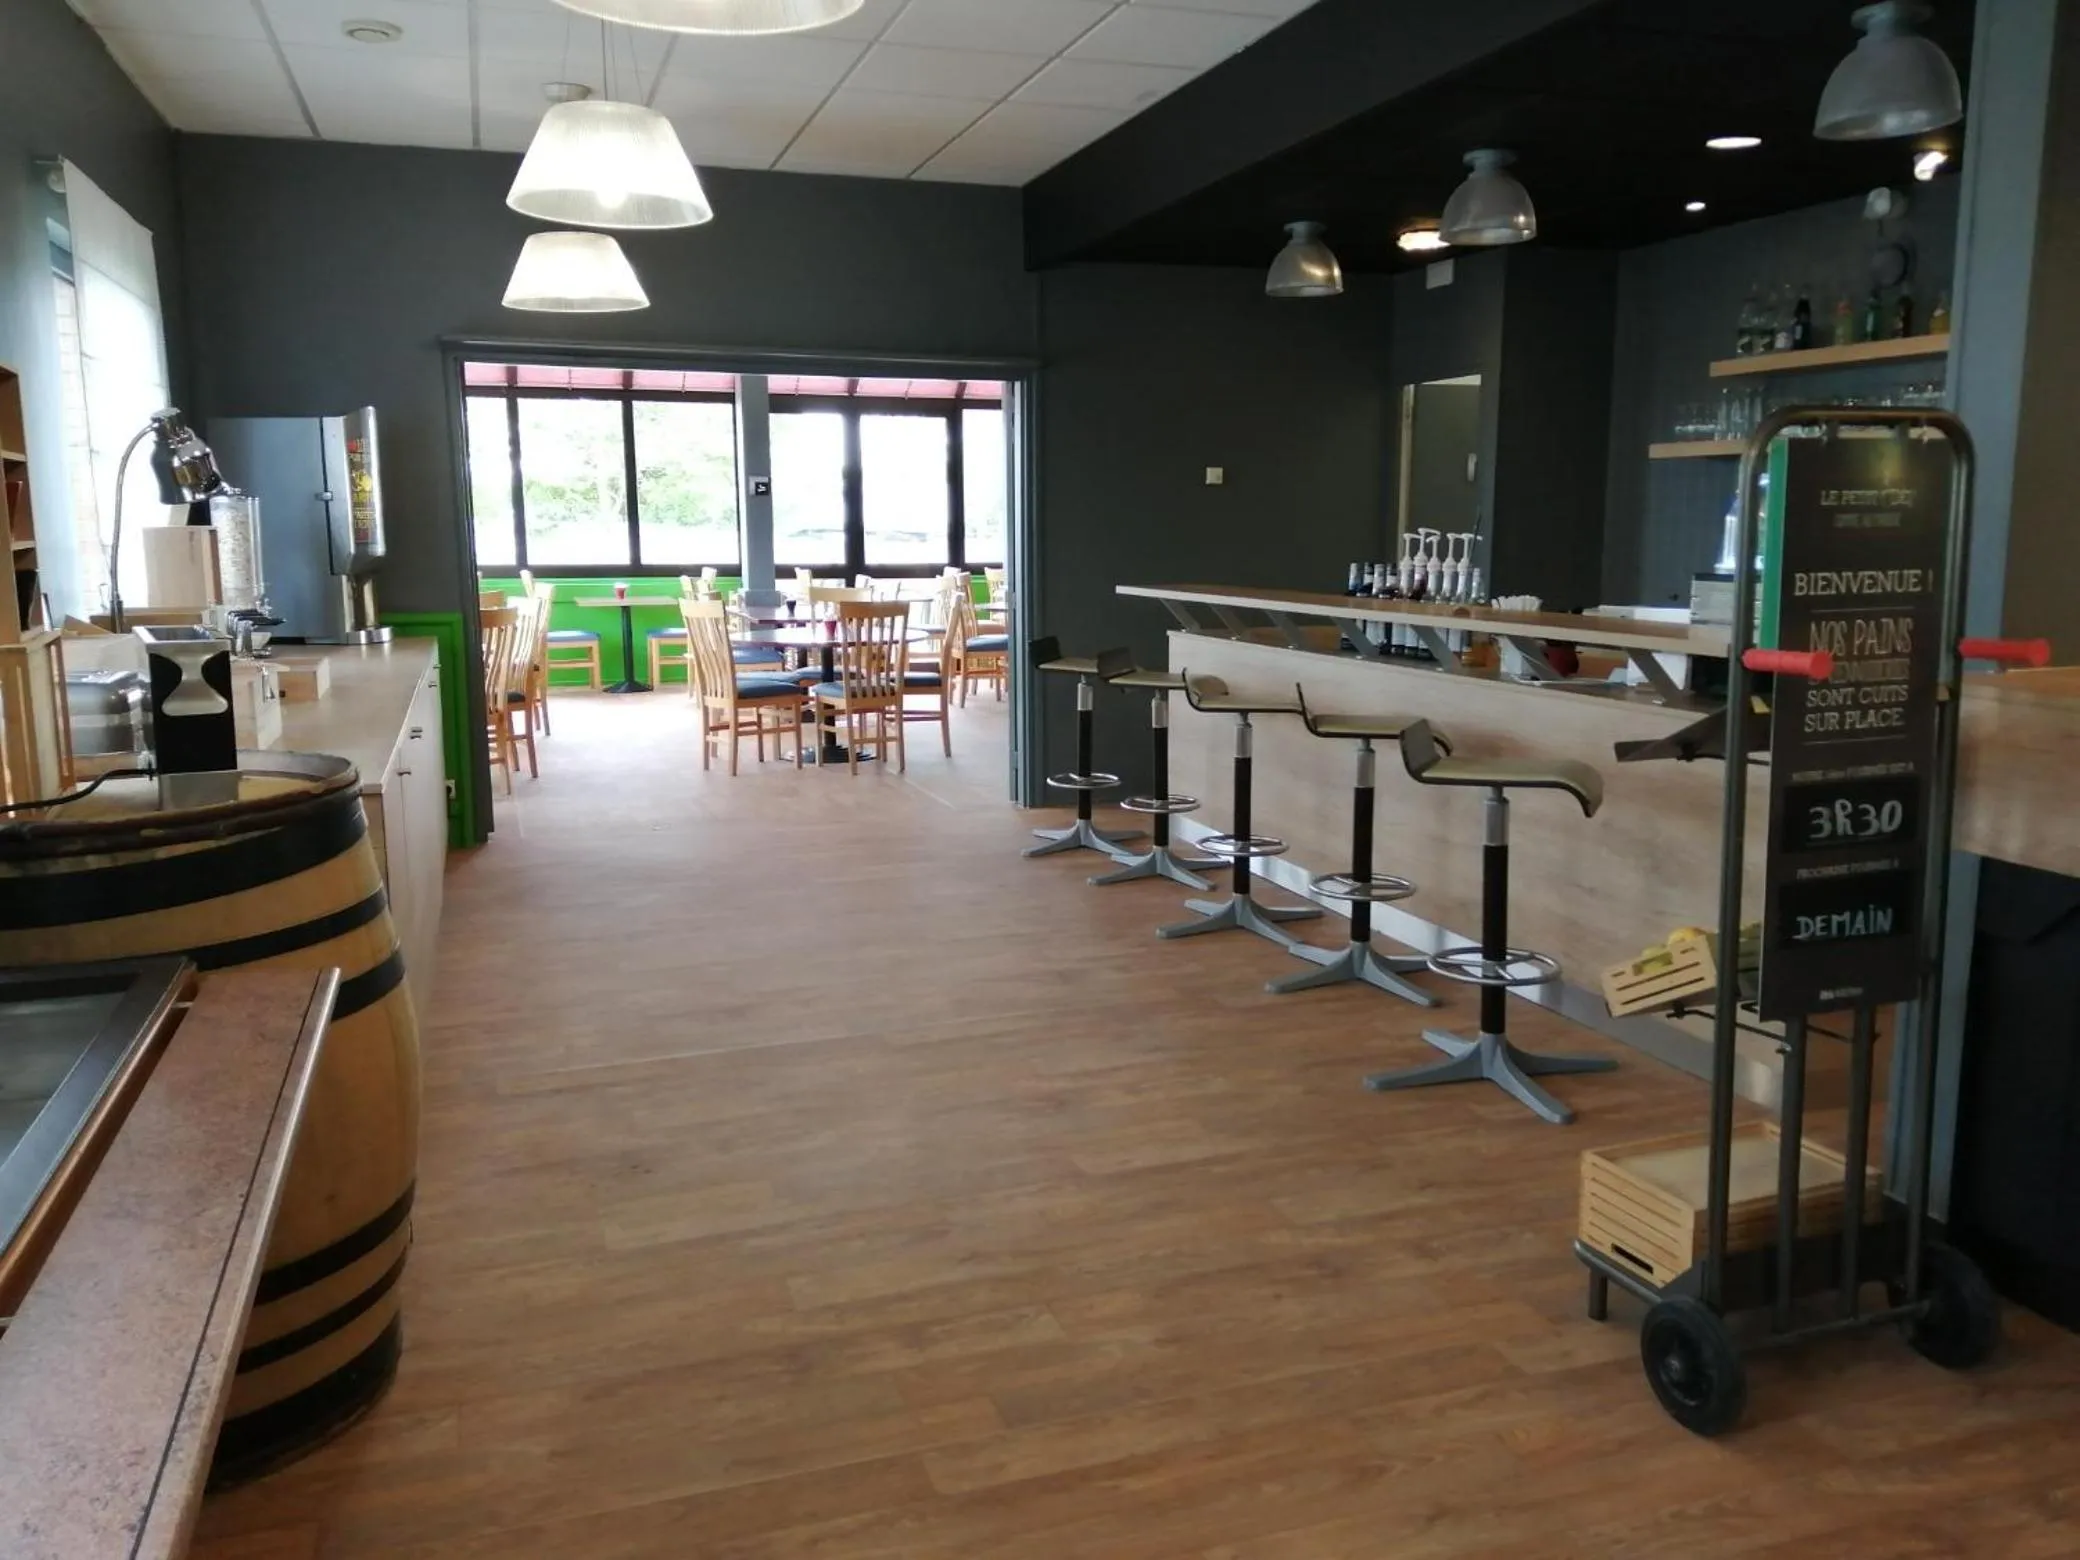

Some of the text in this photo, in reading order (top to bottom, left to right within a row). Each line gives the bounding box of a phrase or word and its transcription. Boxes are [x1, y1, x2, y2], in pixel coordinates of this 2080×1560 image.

[1794, 570, 1922, 596] BIENVENUE
[1809, 618, 1913, 656] NOS PAINS
[1807, 685, 1909, 707] SONT CUITS
[1804, 708, 1905, 732] SUR PLACE
[1792, 904, 1893, 941] DEMAIN
